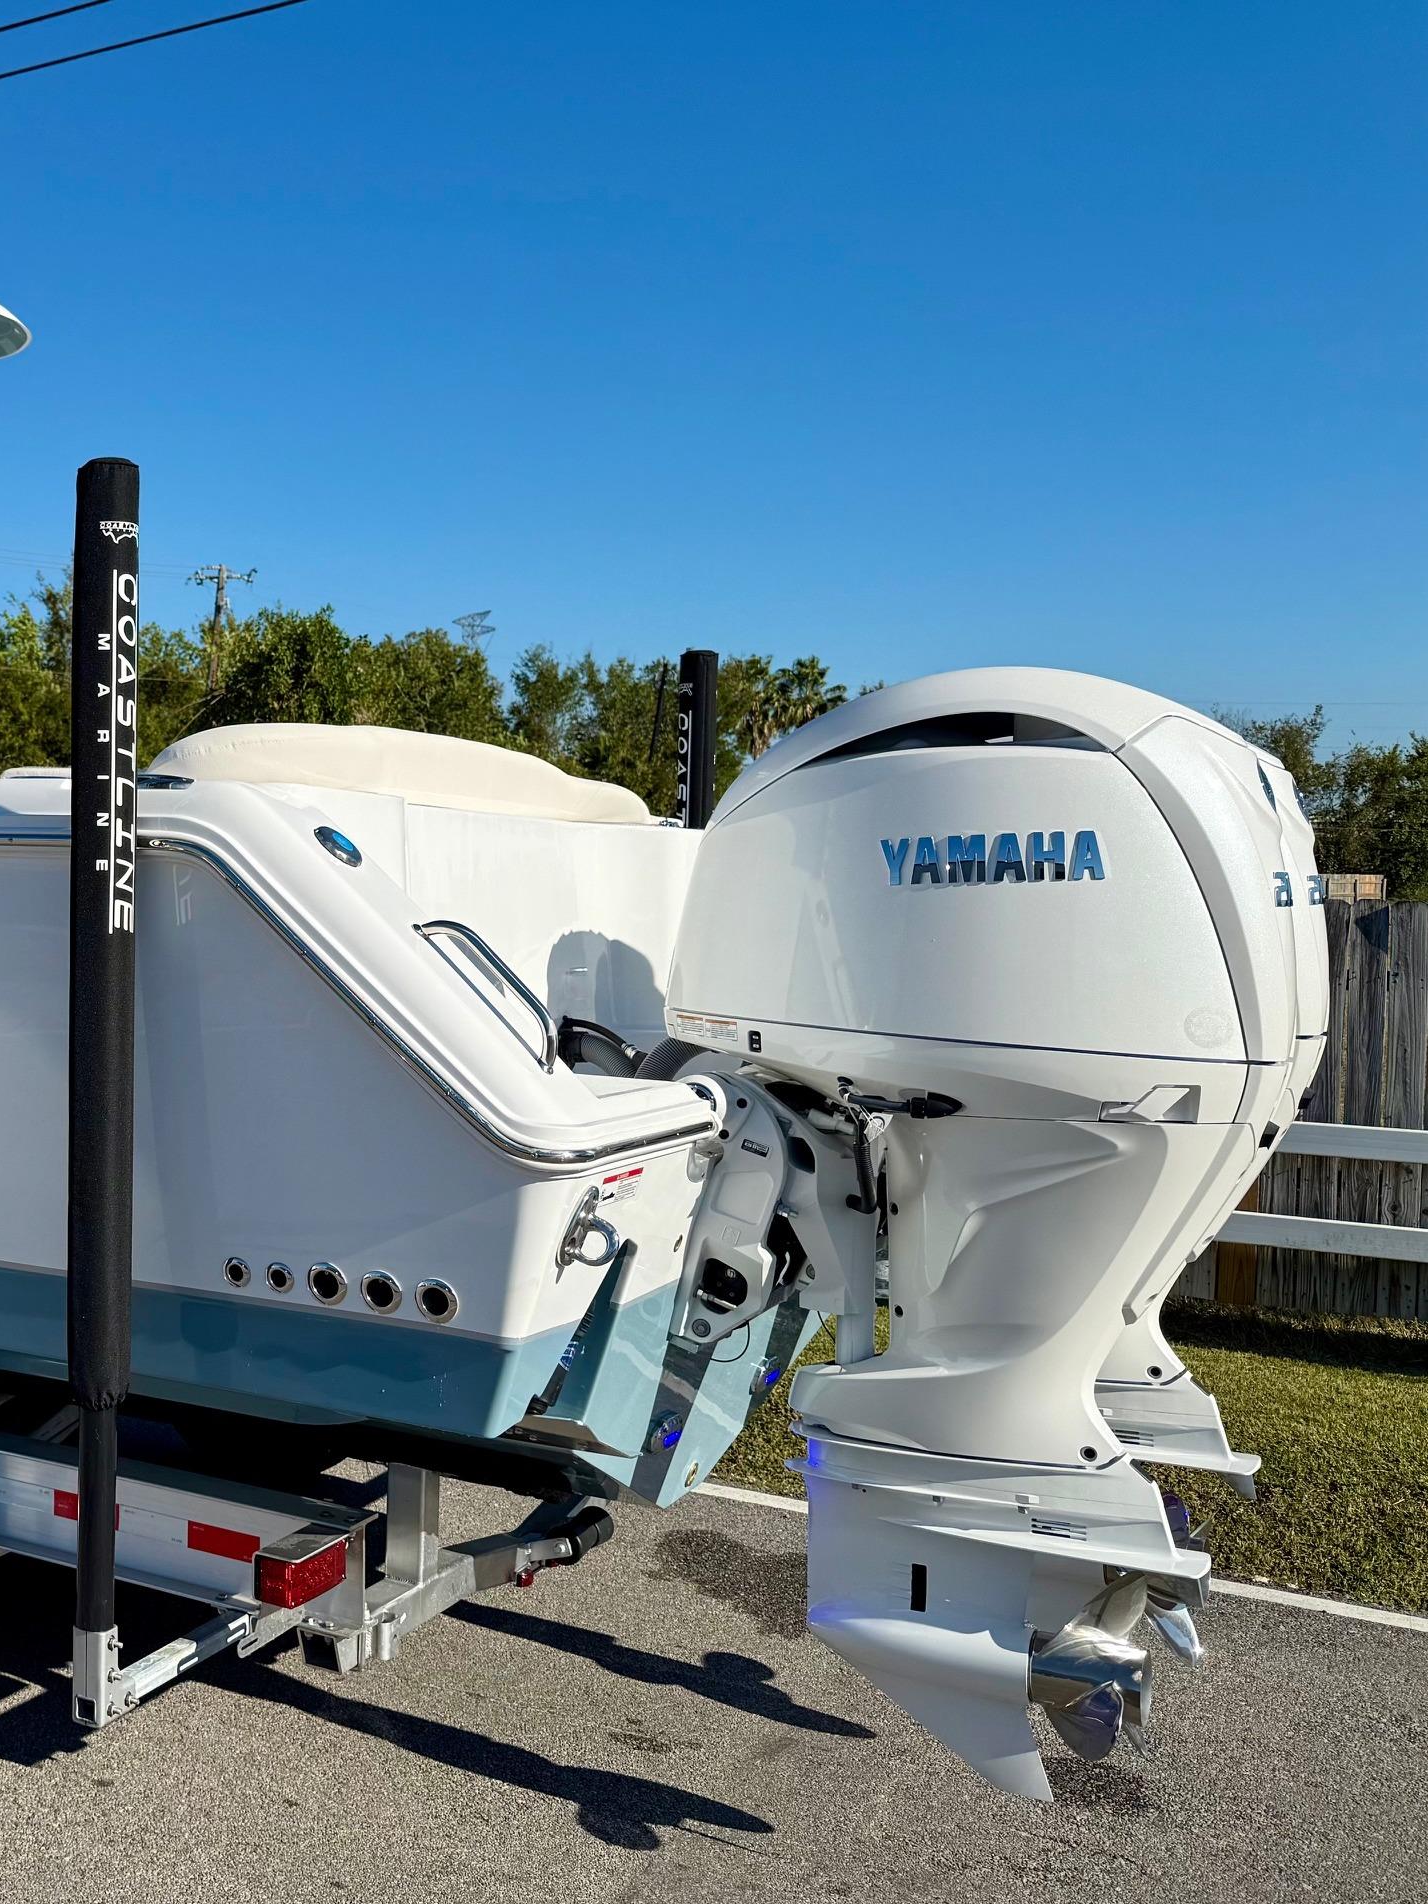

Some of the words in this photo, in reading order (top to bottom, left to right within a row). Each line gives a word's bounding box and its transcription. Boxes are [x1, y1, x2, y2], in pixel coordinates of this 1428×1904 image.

[96, 633, 111, 872] MARINE
[113, 573, 138, 933] COASTLINE
[676, 713, 689, 827] COAST
[880, 829, 1106, 886] YAMAHA
